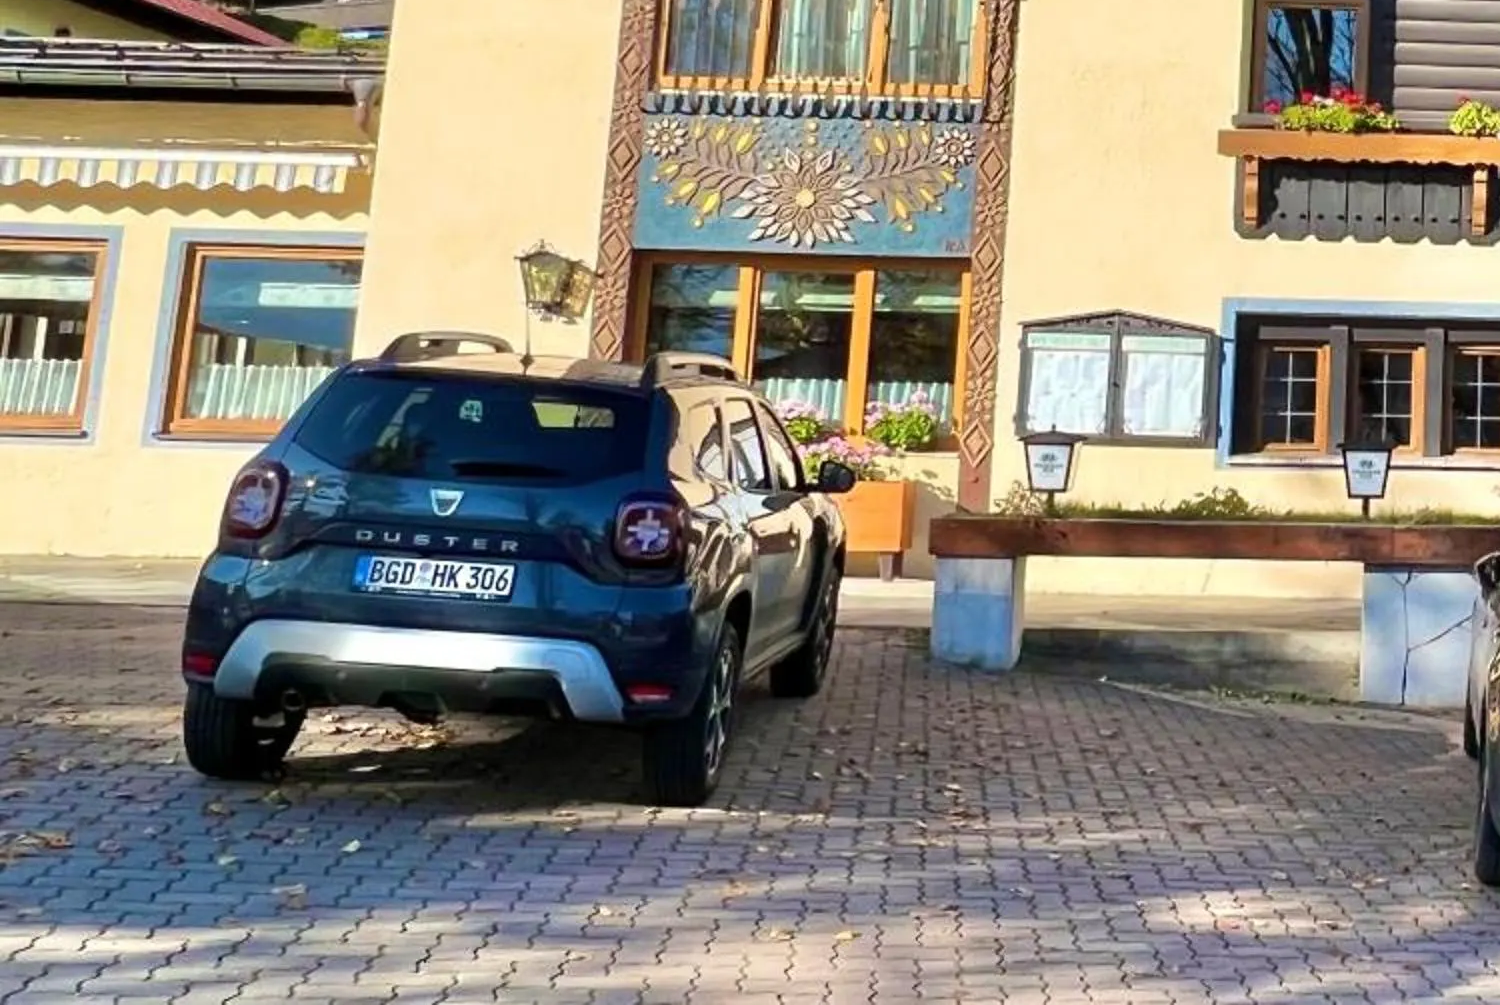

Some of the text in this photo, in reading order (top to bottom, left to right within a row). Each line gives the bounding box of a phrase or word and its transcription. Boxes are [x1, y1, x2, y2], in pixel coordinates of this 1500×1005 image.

[355, 530, 519, 552] DUSTER
[368, 560, 511, 592] BGD HK 306
